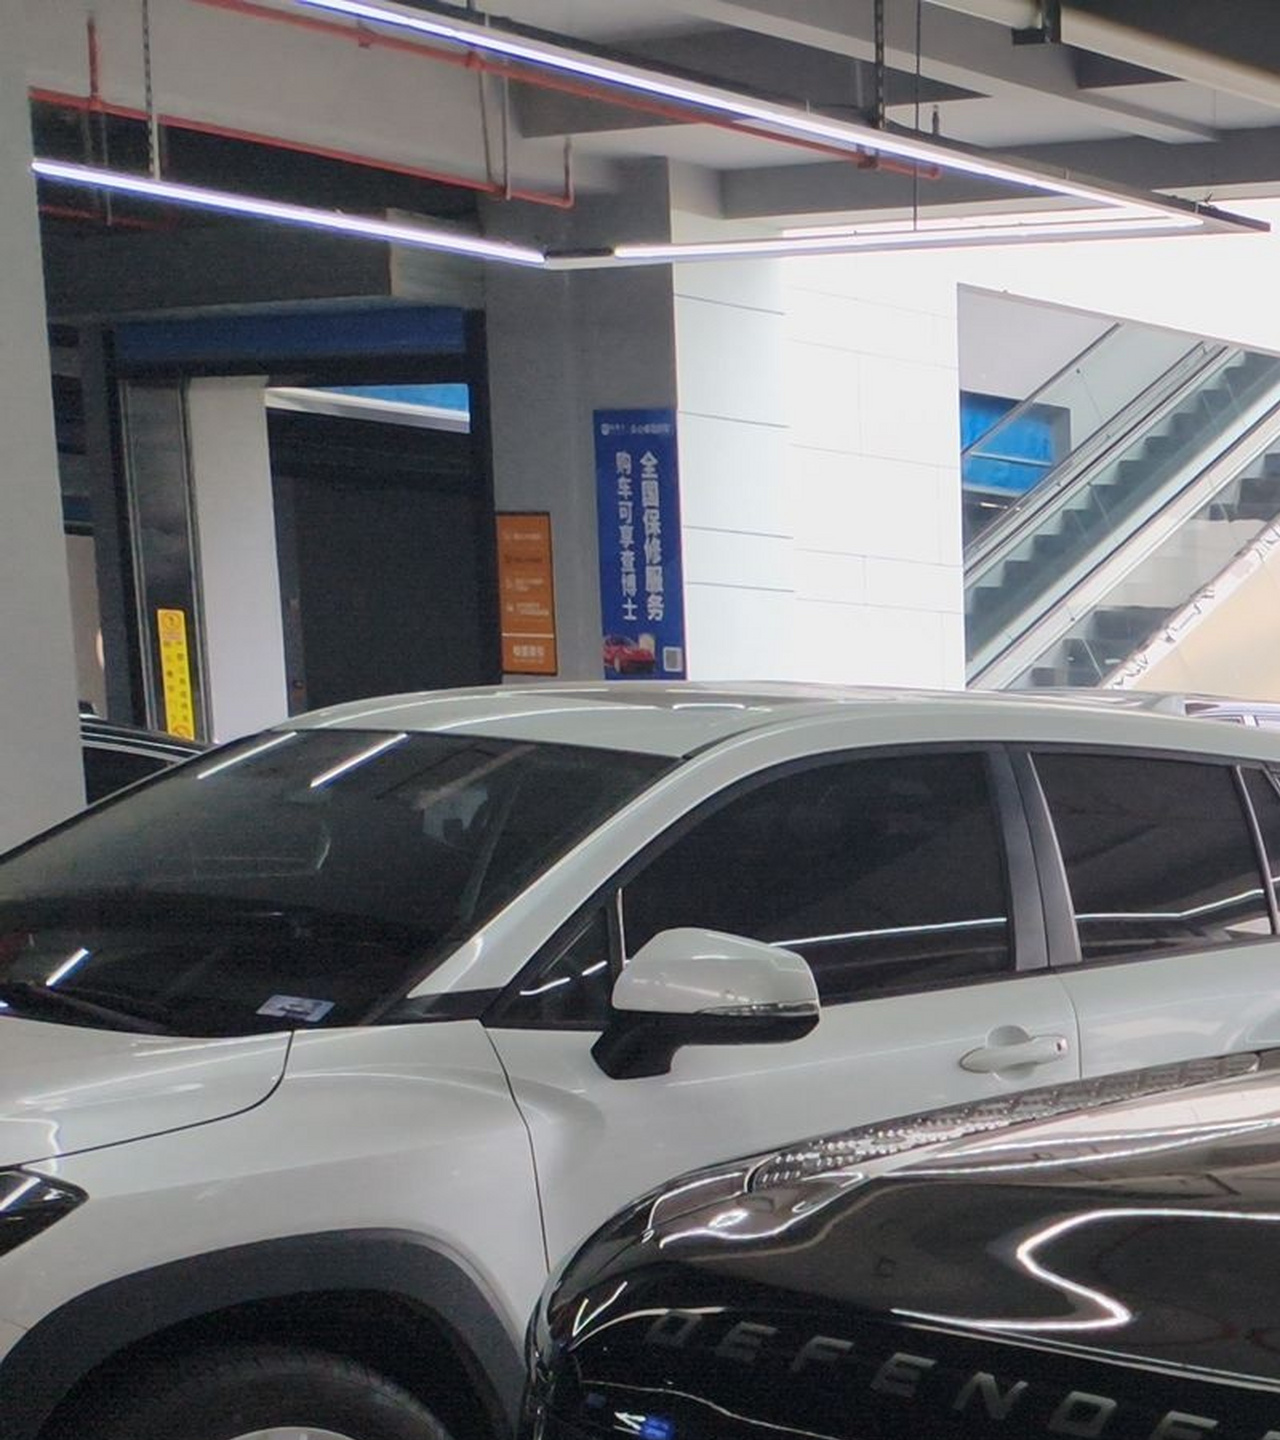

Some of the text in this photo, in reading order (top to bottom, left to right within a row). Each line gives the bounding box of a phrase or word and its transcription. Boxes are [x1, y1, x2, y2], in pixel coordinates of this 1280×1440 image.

[639, 450, 665, 621] 全国保修服务
